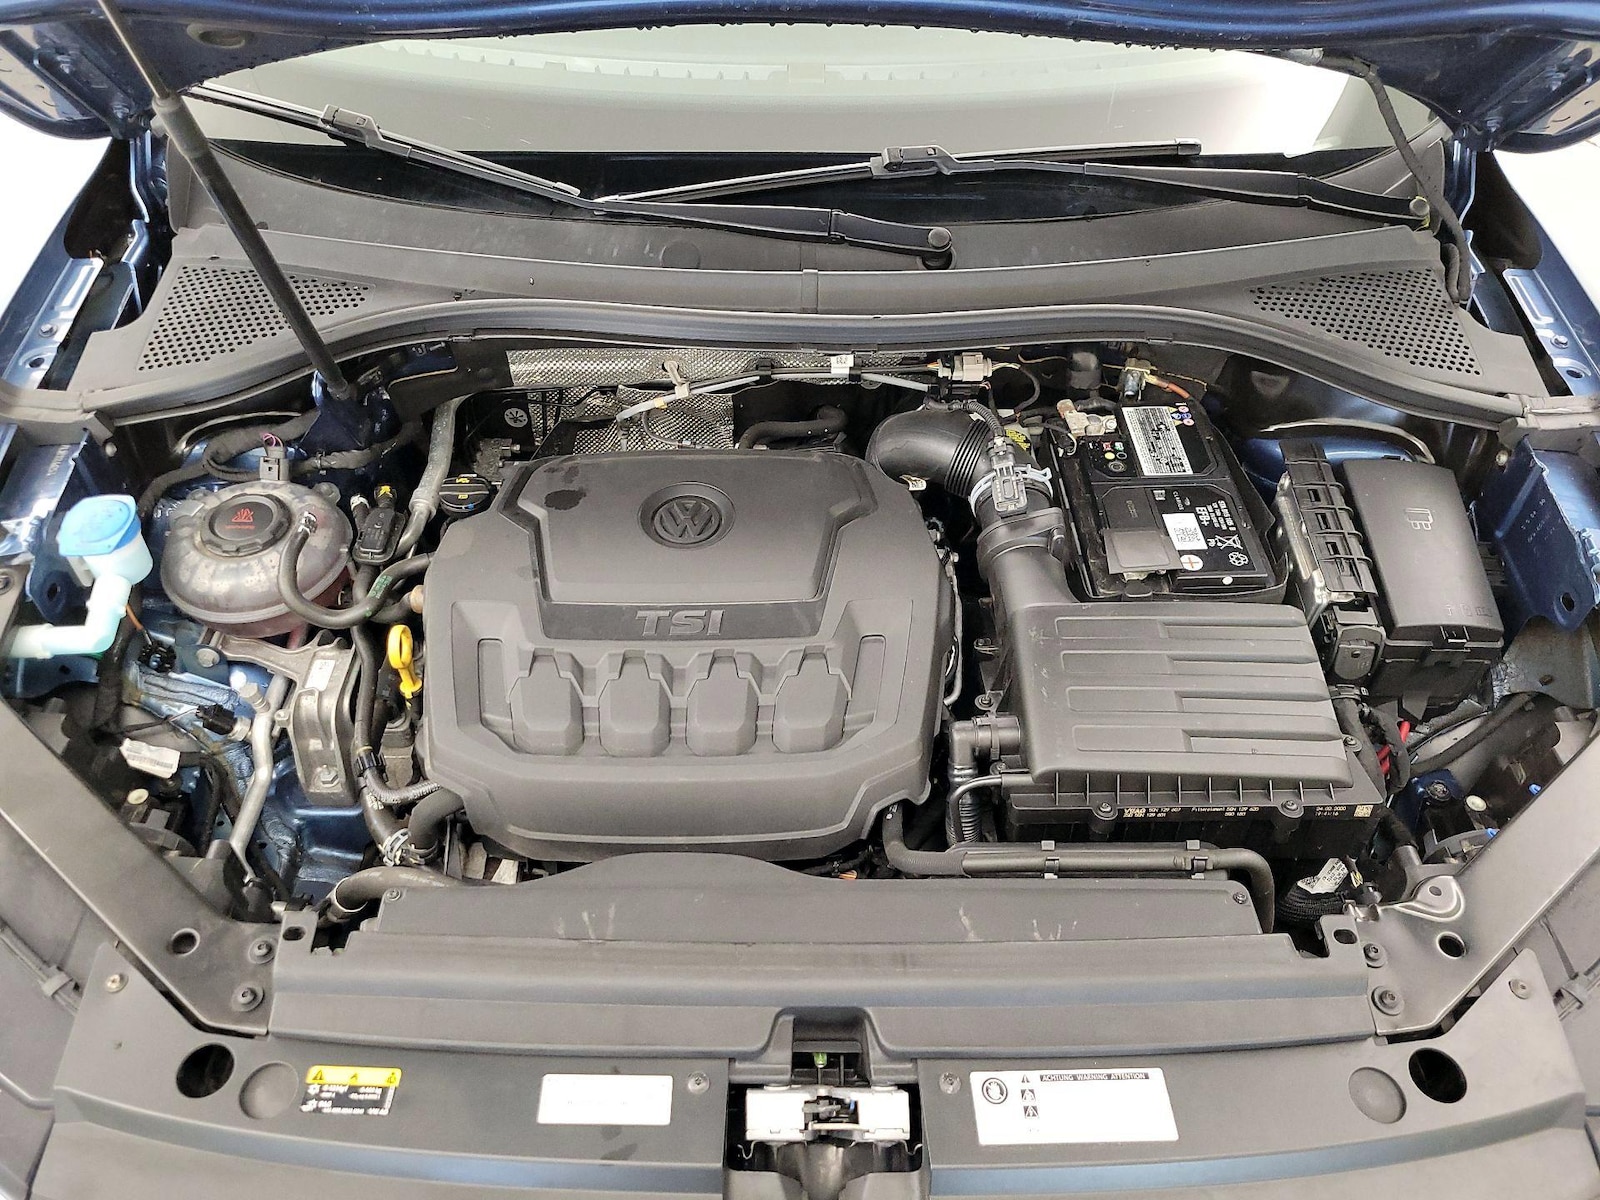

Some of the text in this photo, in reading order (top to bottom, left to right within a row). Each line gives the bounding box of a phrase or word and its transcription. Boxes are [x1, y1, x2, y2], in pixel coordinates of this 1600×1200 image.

[1195, 506, 1210, 526] EFB+
[635, 610, 725, 636] TSI
[1075, 1073, 1108, 1081] WARNING
[1110, 1072, 1146, 1080] ATTENTION
